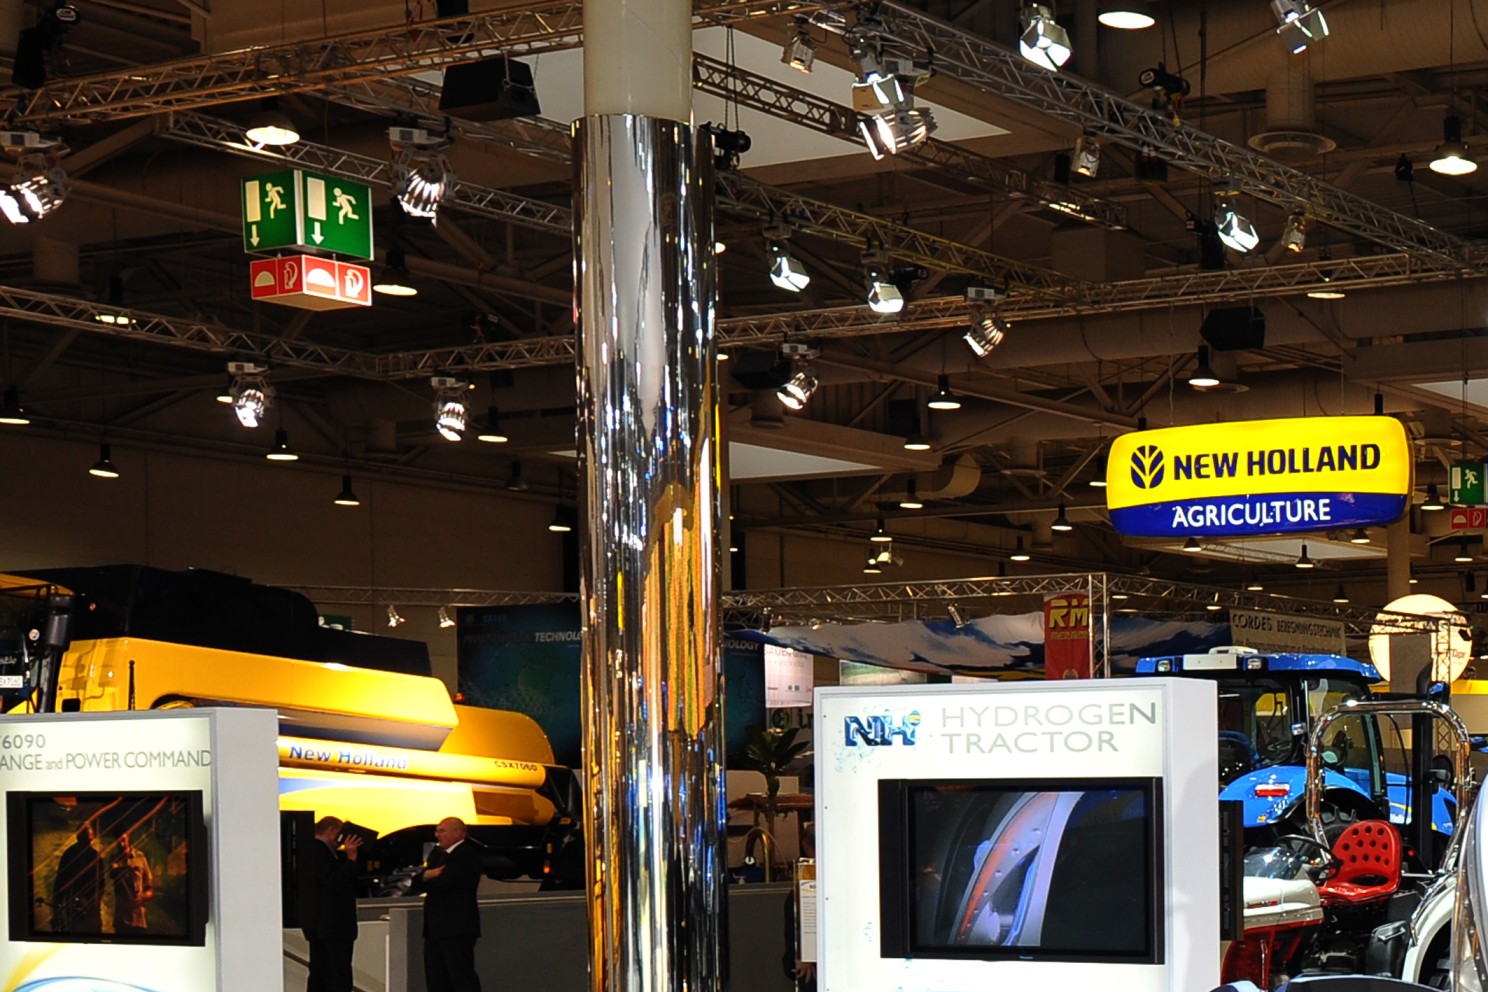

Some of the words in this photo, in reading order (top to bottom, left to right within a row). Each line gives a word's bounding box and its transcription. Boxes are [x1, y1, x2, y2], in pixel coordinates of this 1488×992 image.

[1174, 452, 1239, 480] NEW
[1246, 443, 1381, 477] HOLLAND
[1171, 498, 1332, 529] AGRICULTURE
[1049, 597, 1089, 628] RM
[1232, 613, 1272, 631] CORDES
[941, 702, 1156, 728] HYDROGEN
[0, 734, 46, 750] 6090
[940, 730, 1119, 754] TRACTOR
[0, 753, 43, 771] ANGE
[45, 757, 63, 770] and
[66, 752, 121, 770] POWER
[124, 750, 212, 768] COMMAND
[289, 746, 331, 762] New
[338, 747, 407, 770] Holland
